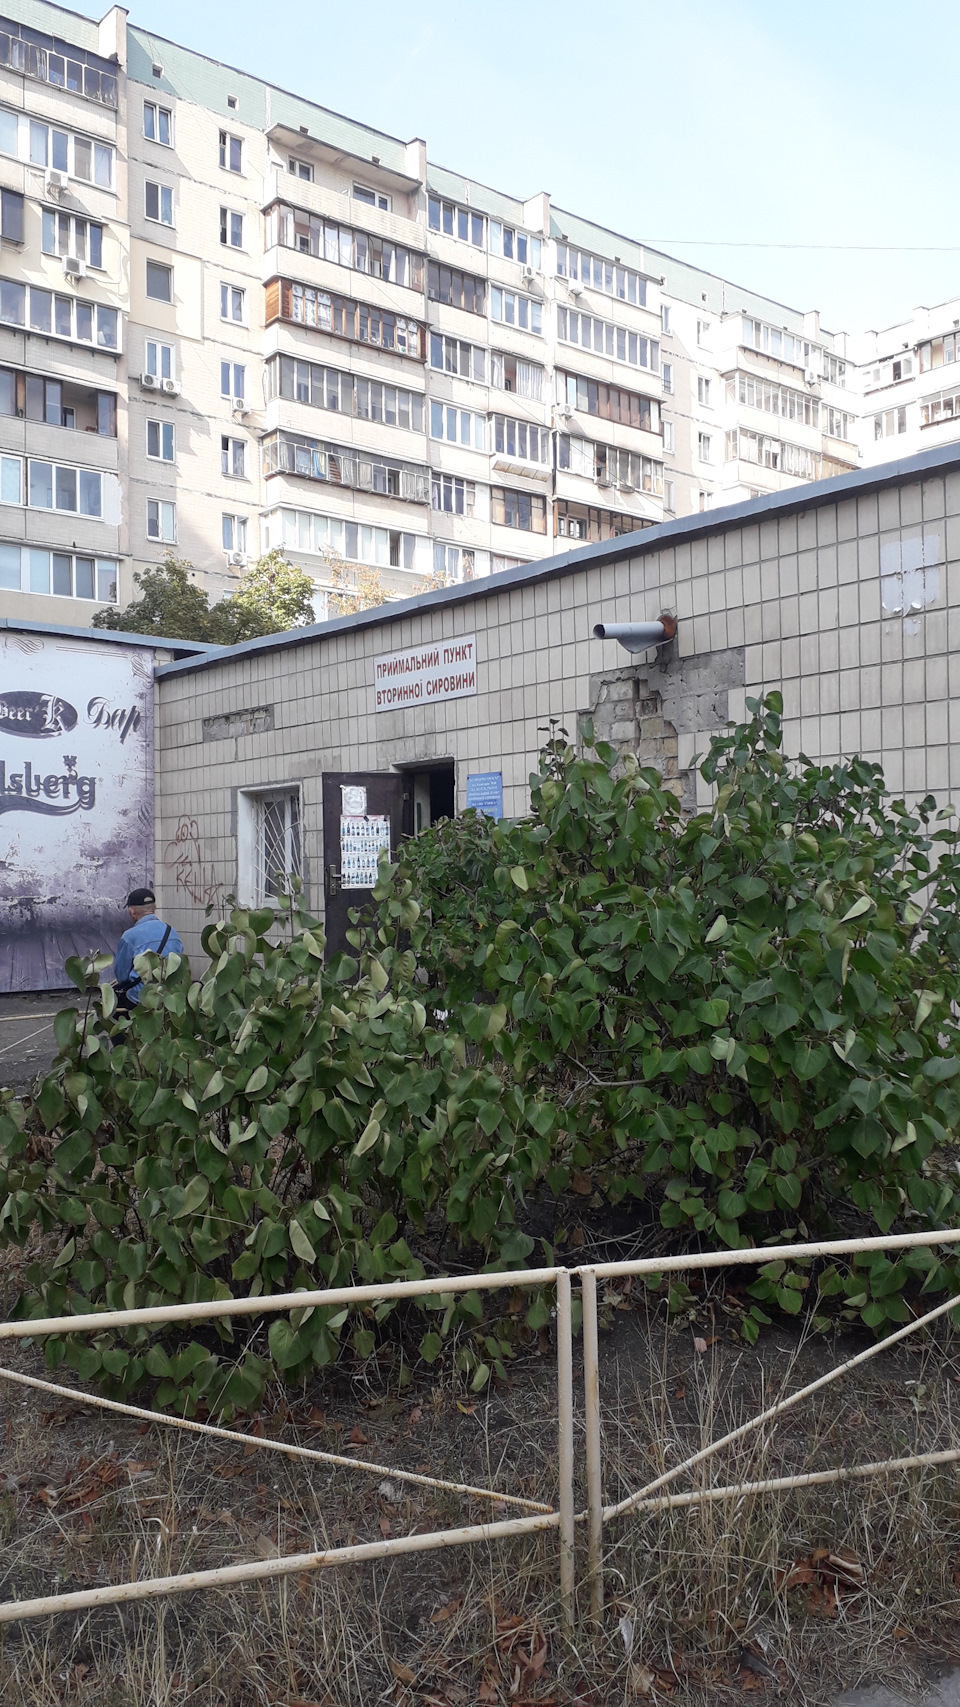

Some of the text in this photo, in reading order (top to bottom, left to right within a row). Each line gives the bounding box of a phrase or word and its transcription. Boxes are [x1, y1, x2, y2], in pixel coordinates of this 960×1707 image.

[376, 643, 473, 679] ПРИЙМАЛЬНИЙ ПУНКТ
[376, 671, 475, 705] ВТОРИННОЇ СИРОВИНИ
[84, 696, 141, 745] Бар
